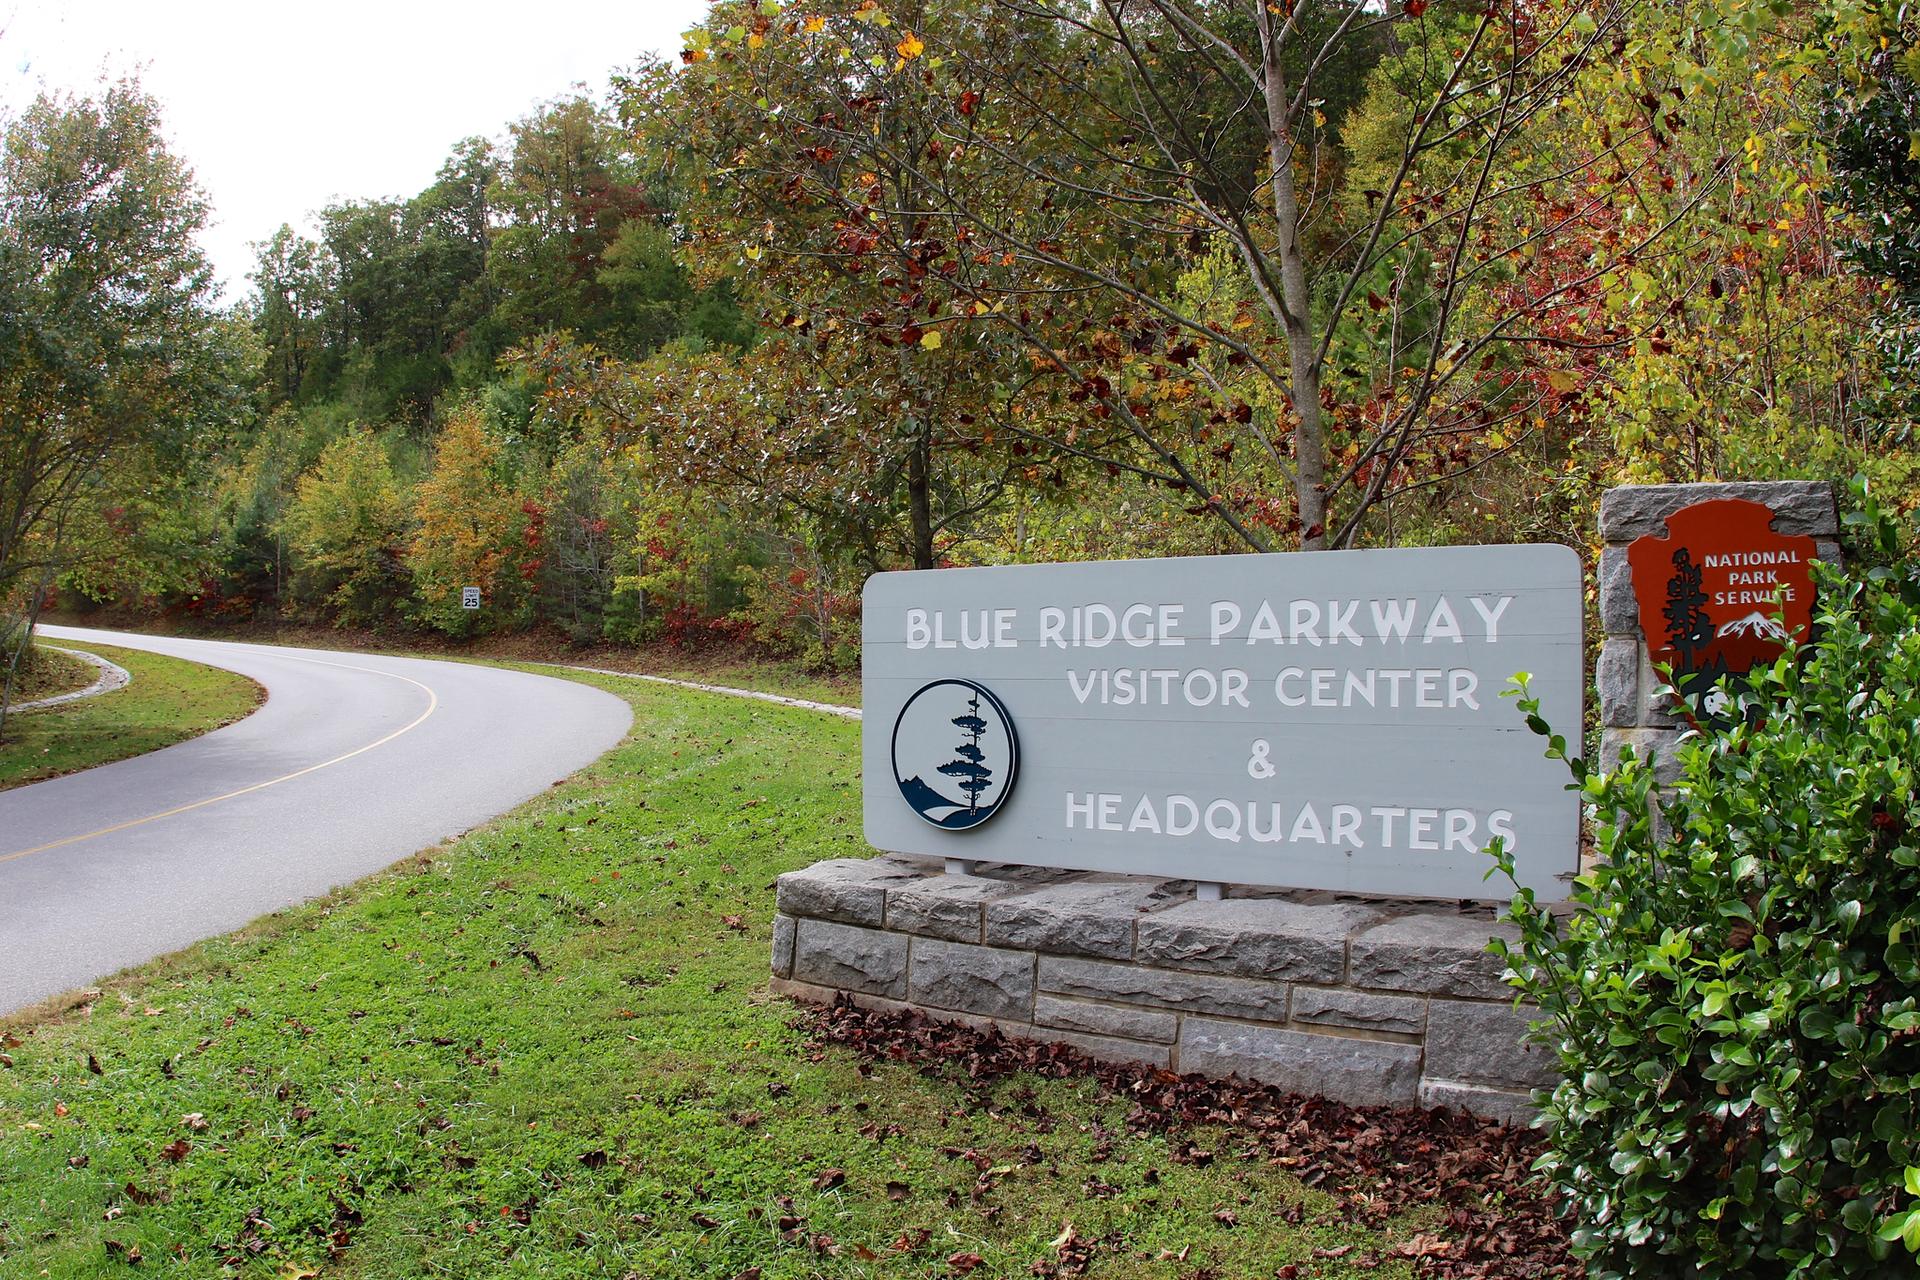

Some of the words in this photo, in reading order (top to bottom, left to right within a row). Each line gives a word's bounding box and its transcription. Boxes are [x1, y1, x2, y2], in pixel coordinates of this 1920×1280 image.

[1705, 550, 1800, 568] NATIONAL
[1729, 570, 1778, 585] PARK
[464, 598, 478, 607] 25
[1715, 588, 1796, 605] SERVIE
[906, 607, 1019, 650] BLUE
[1039, 603, 1186, 648] RIDGE
[1209, 595, 1516, 646] PARKWAY
[1066, 668, 1251, 708] VISITOR
[1275, 667, 1480, 710] CENTER
[1247, 738, 1276, 779] &
[1066, 791, 1516, 853] HEADQUARTERS
